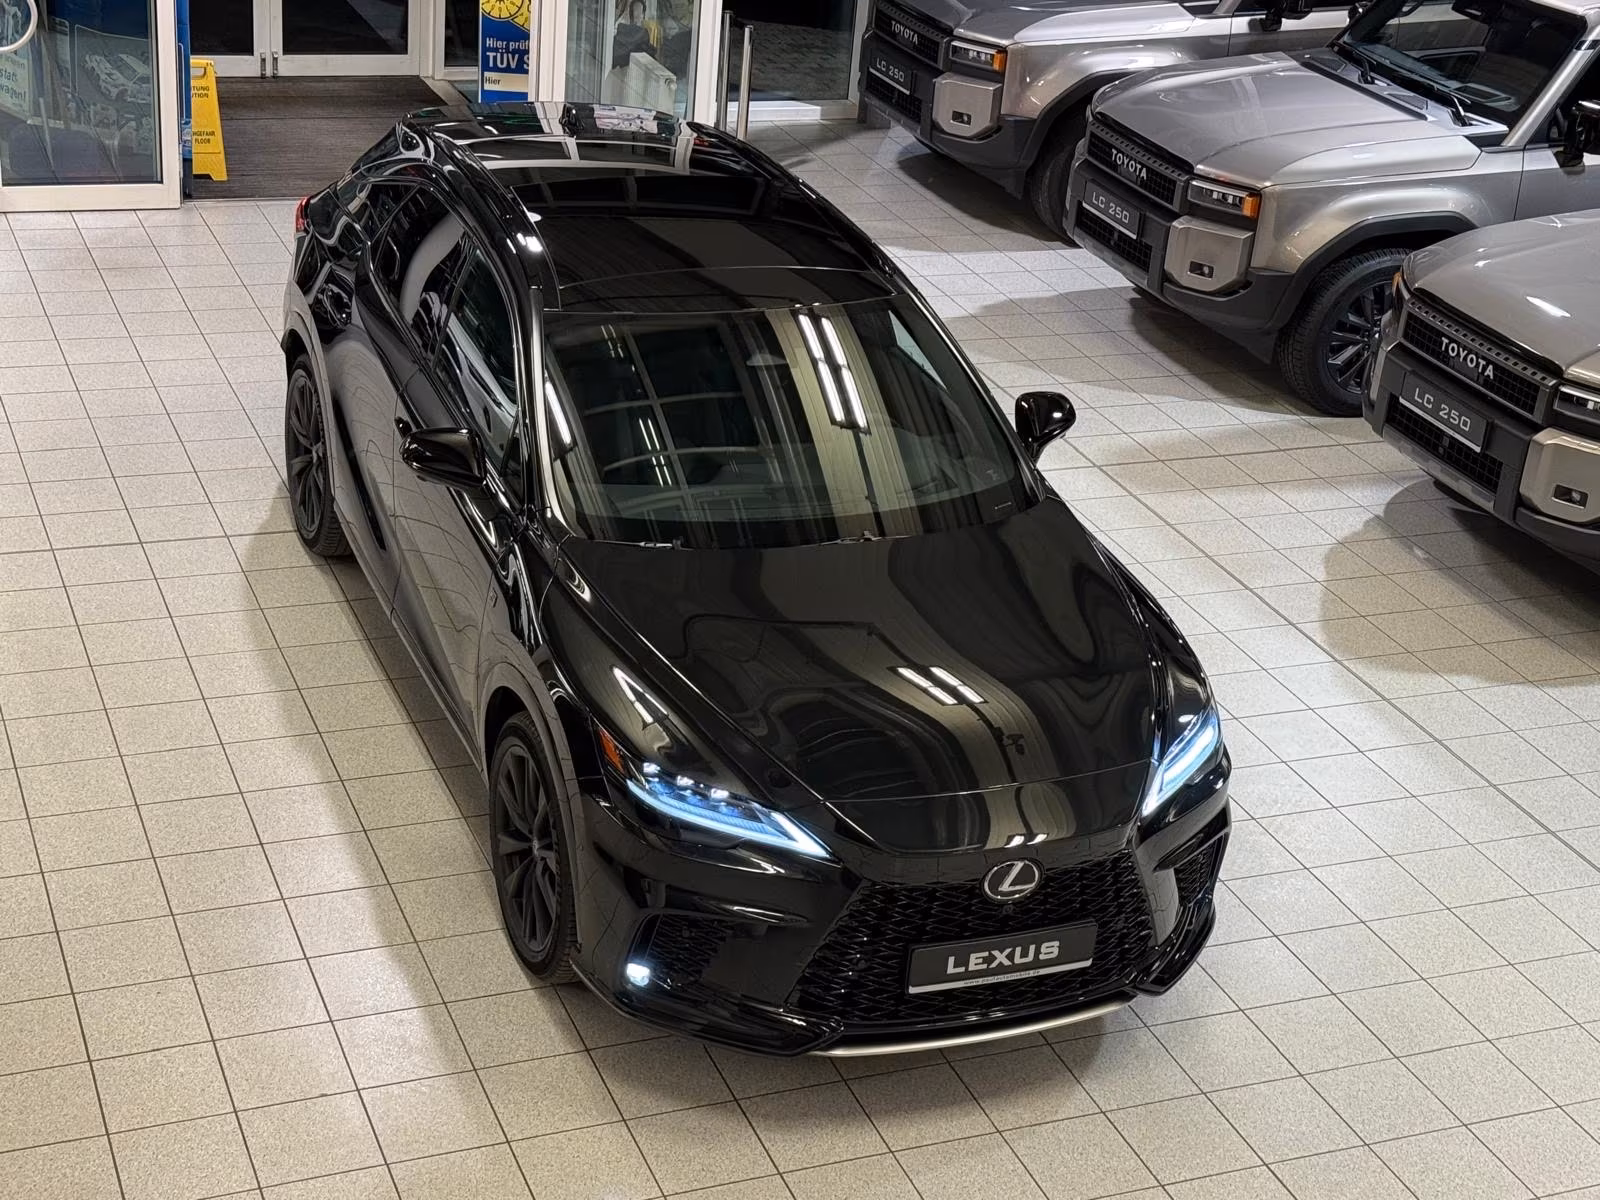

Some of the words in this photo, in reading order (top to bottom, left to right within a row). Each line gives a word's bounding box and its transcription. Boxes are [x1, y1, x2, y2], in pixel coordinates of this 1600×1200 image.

[486, 37, 506, 48] Hier
[891, 20, 919, 45] TOYOTA
[486, 49, 519, 69] TÜV
[876, 57, 886, 71] LC
[889, 66, 905, 83] 250
[485, 76, 501, 85] Hier
[1112, 149, 1147, 180] TOYOTA
[1092, 192, 1105, 208] LC
[1109, 203, 1130, 224] 250
[1441, 337, 1495, 380] TOYOTA
[1414, 387, 1434, 409] LC
[1439, 404, 1471, 432] 250
[946, 941, 1060, 975] LEXUS
